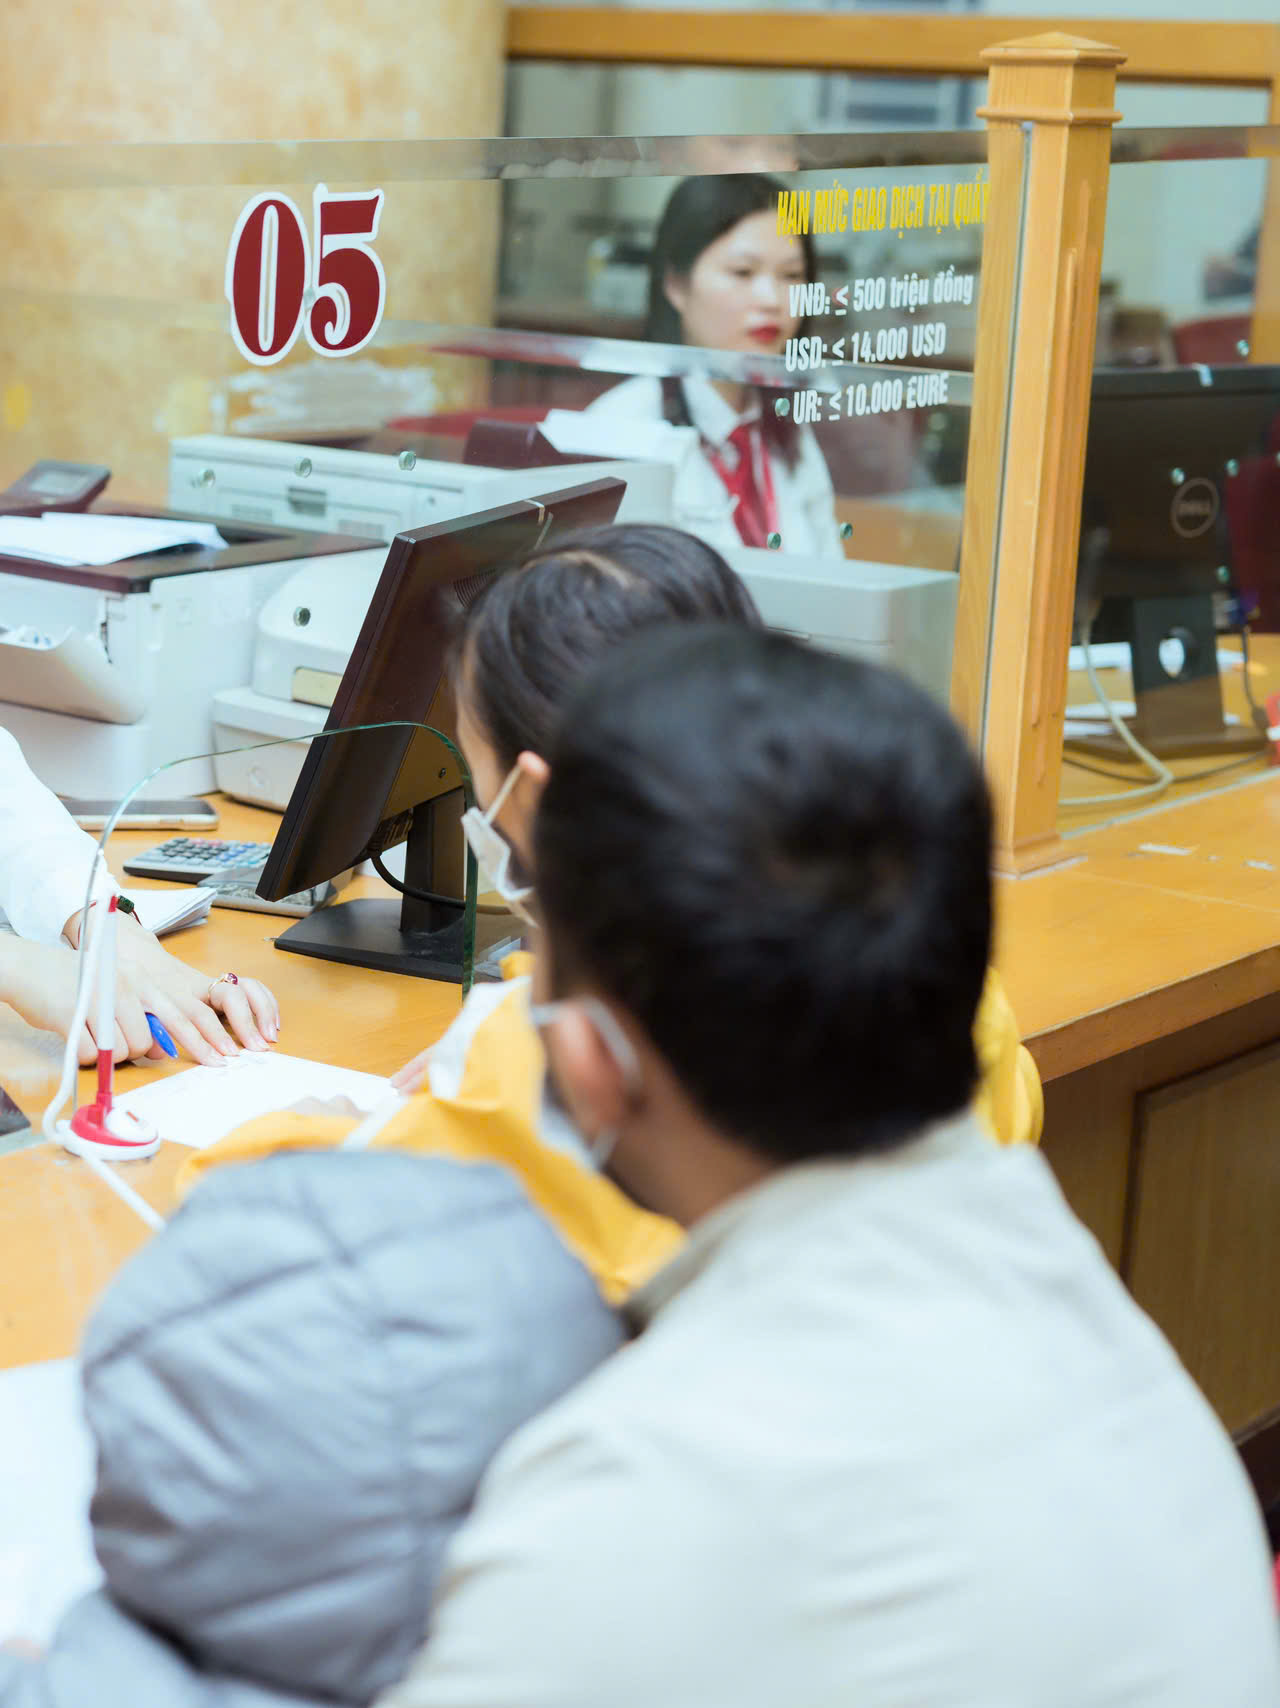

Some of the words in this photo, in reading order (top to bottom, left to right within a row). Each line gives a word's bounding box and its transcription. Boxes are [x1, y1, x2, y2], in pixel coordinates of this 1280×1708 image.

[776, 190, 811, 247] HẠN
[813, 179, 849, 235] MỨC
[852, 187, 887, 233] GIAO
[890, 183, 926, 239] DỊCH
[928, 183, 951, 235] TẠI
[225, 184, 385, 364] 05
[788, 282, 830, 318] VNĐ:
[853, 277, 886, 313] 500
[890, 272, 930, 313] triệu
[933, 265, 974, 305] đồng
[785, 336, 827, 373] USD:
[851, 326, 908, 364] 14.000
[912, 322, 947, 358] USD
[846, 378, 903, 418] 10.000
